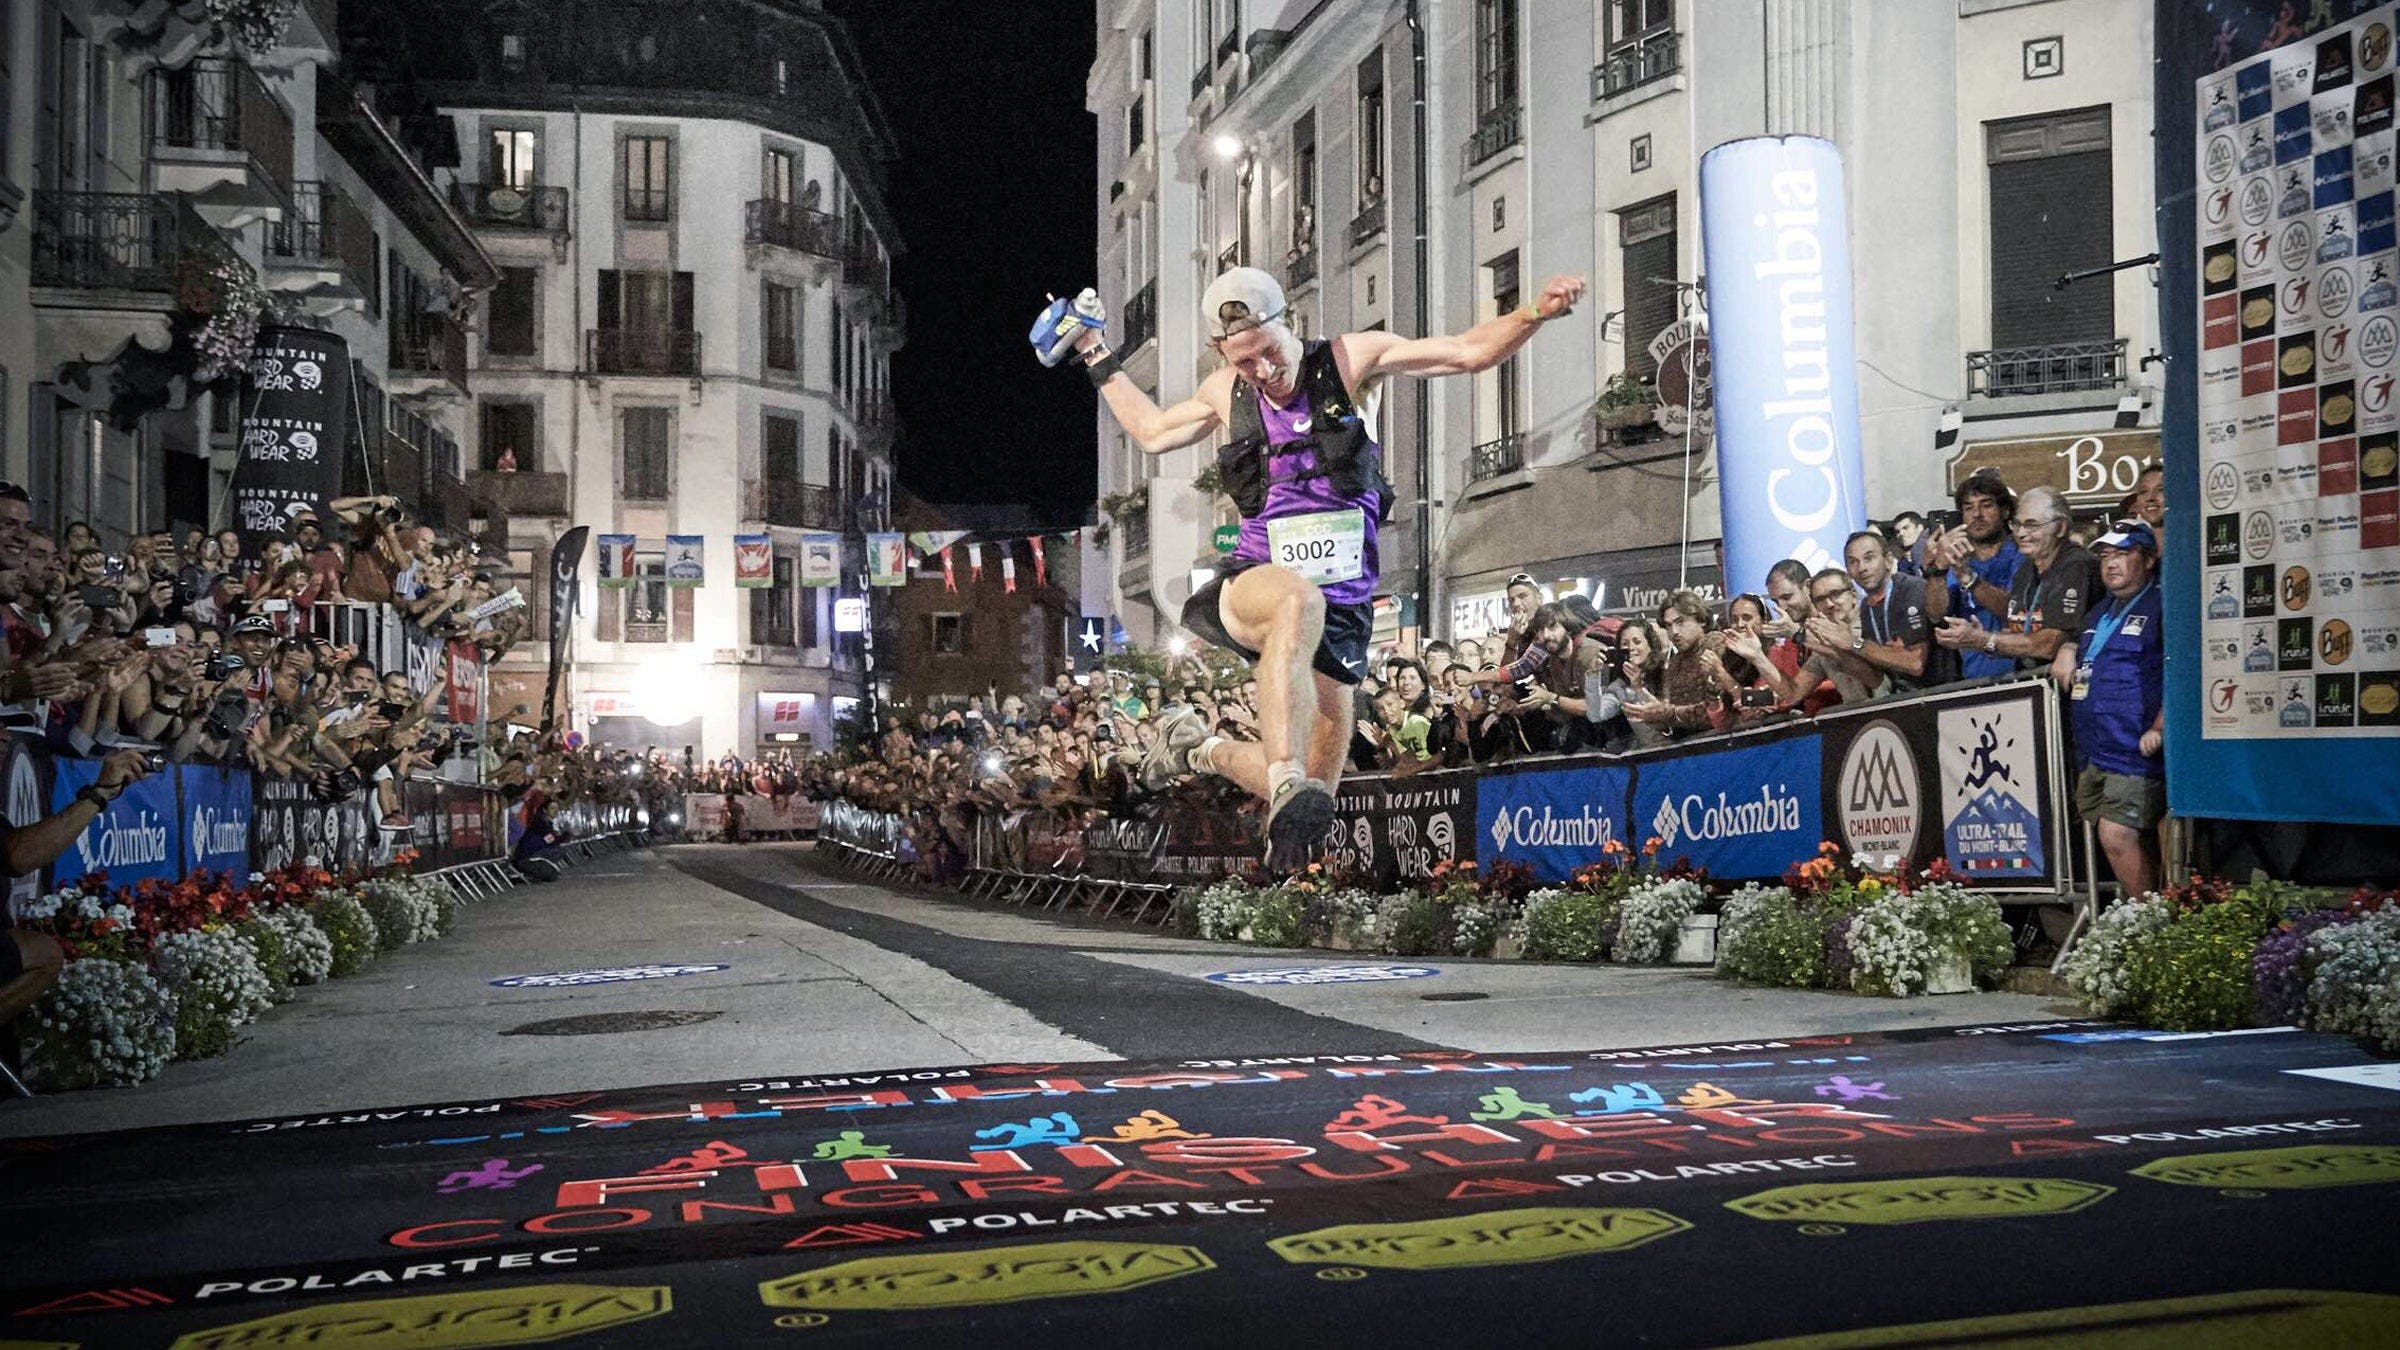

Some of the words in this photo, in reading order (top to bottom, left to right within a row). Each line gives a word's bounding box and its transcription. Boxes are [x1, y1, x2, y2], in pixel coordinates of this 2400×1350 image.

[252, 348, 327, 362] OUNTAIN
[1754, 168, 1838, 532] Columbia
[243, 418, 323, 432] MOUNTAIN
[244, 429, 280, 447] HARD
[250, 445, 290, 462] WEAR
[239, 488, 319, 502] MOUNTAIN
[240, 499, 276, 517] HARD
[246, 515, 287, 533] WEAR
[1281, 539, 1336, 563] 3002
[1622, 587, 1668, 609] Vivre
[1333, 795, 1374, 812] UNTAIN
[1385, 788, 1460, 810] MOUNTAIN
[1681, 783, 1800, 842] Columbia
[1388, 814, 1418, 848] HARD
[1514, 805, 1611, 847] Columbia
[1850, 815, 1912, 838] CHAMONIX
[1957, 822, 2028, 841] ULTRA-TRAIL
[87, 811, 166, 867] Columbia
[1861, 838, 1900, 852] MONT-BLANC
[1397, 847, 1435, 879] WEAR
[732, 1069, 971, 1092] POLARTEC
[245, 1103, 502, 1133] POLARTEC
[2093, 1119, 2352, 1145] POLARTEC
[389, 1113, 2077, 1249] CONGRATULATIONS
[1555, 1154, 1850, 1188] POLARTEC
[928, 1200, 1265, 1234] POLARTEC
[195, 1247, 579, 1299] POLARTEC
